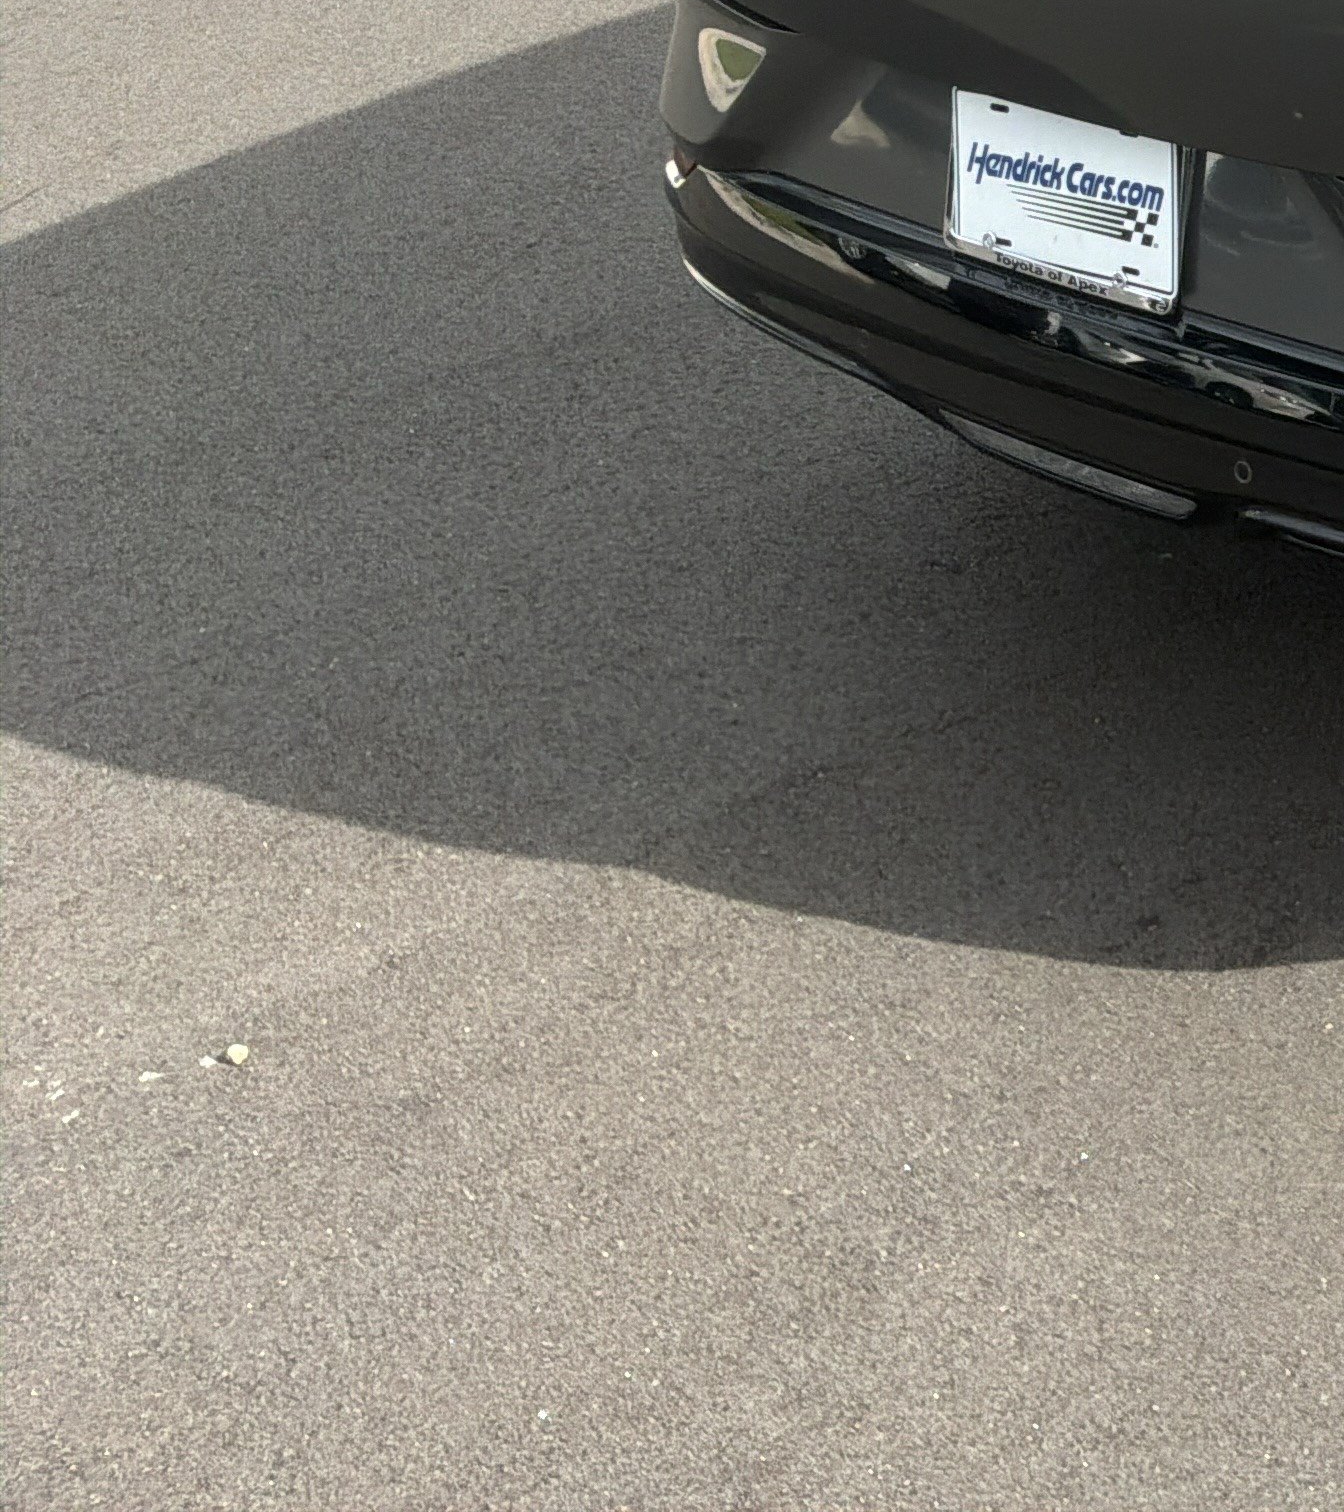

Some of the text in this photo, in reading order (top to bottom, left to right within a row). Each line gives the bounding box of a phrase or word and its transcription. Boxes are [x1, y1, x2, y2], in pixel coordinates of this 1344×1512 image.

[993, 251, 1109, 296] Toyota of Apex
